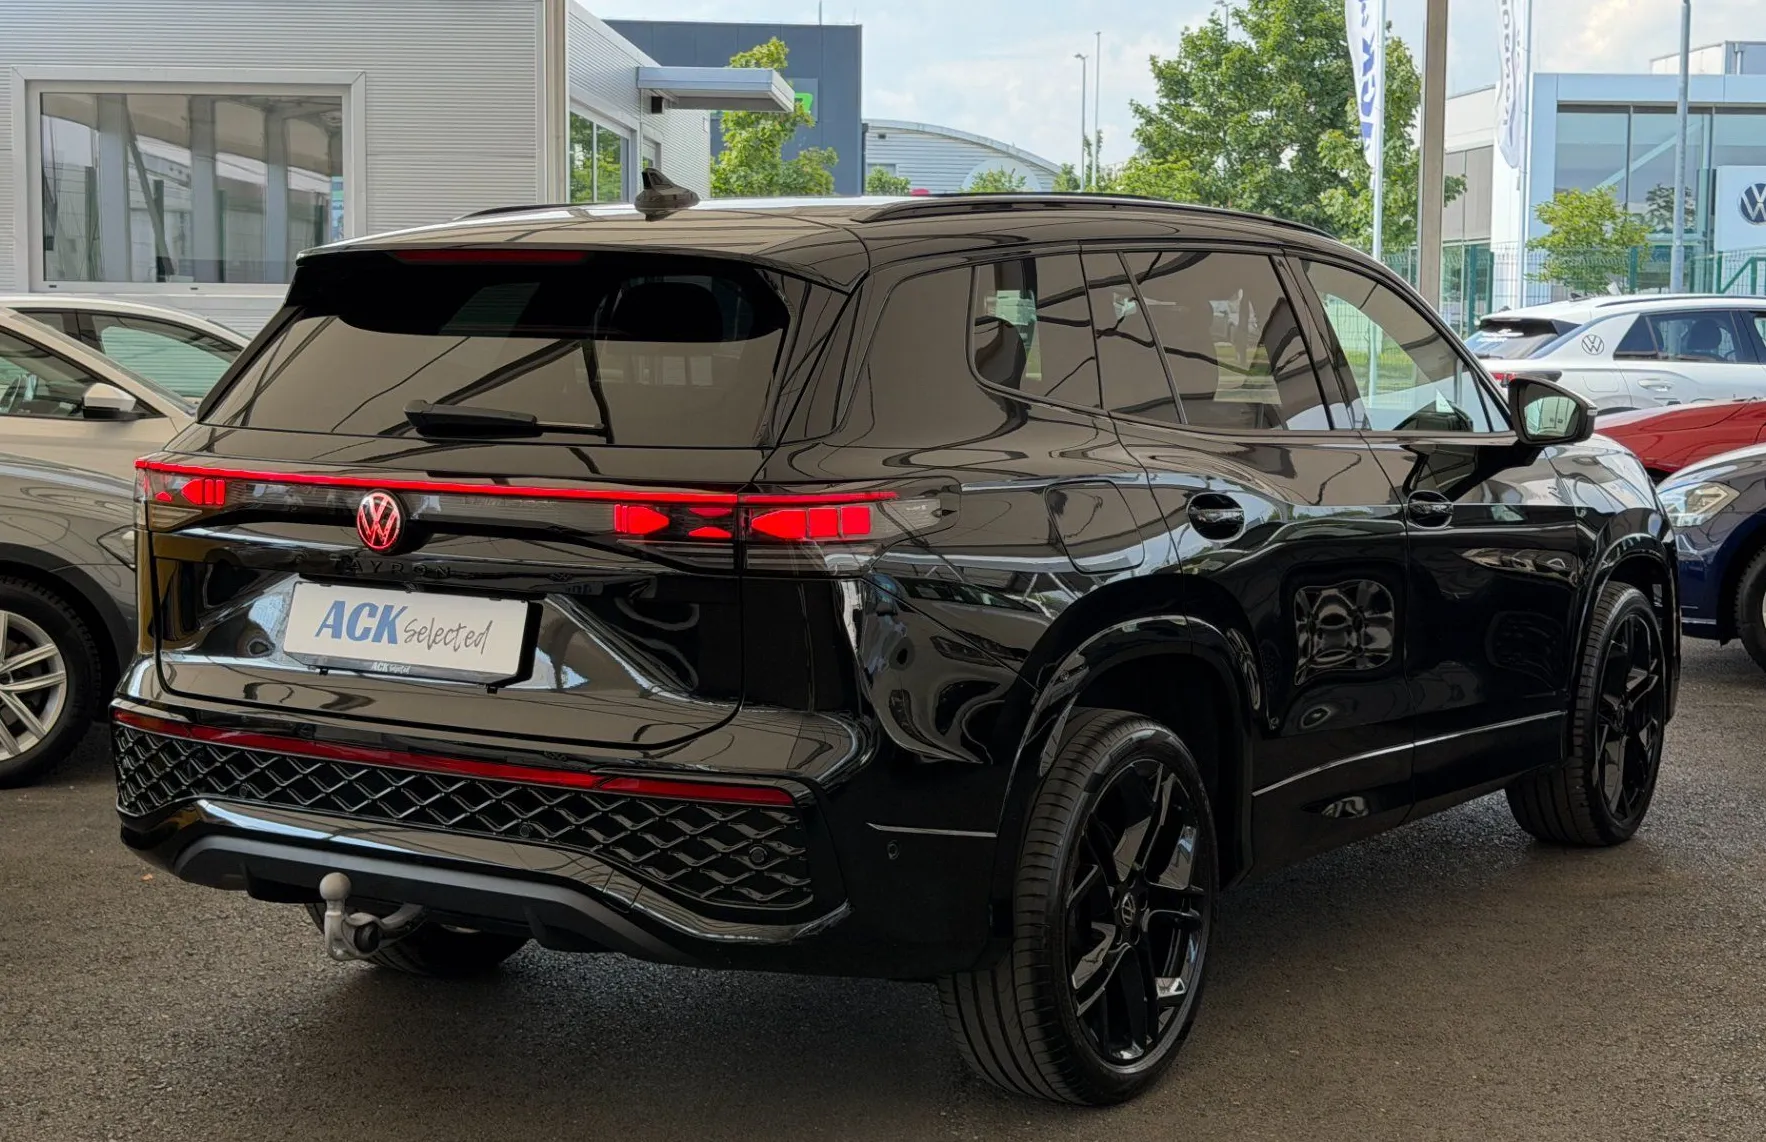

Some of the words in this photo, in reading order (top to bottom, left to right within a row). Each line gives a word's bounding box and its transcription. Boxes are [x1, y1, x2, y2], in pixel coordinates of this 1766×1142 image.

[357, 492, 401, 549] VW
[329, 554, 451, 579] TAYRON
[314, 600, 408, 645] ACK
[404, 617, 493, 655] Selected
[371, 661, 390, 673] ACK
